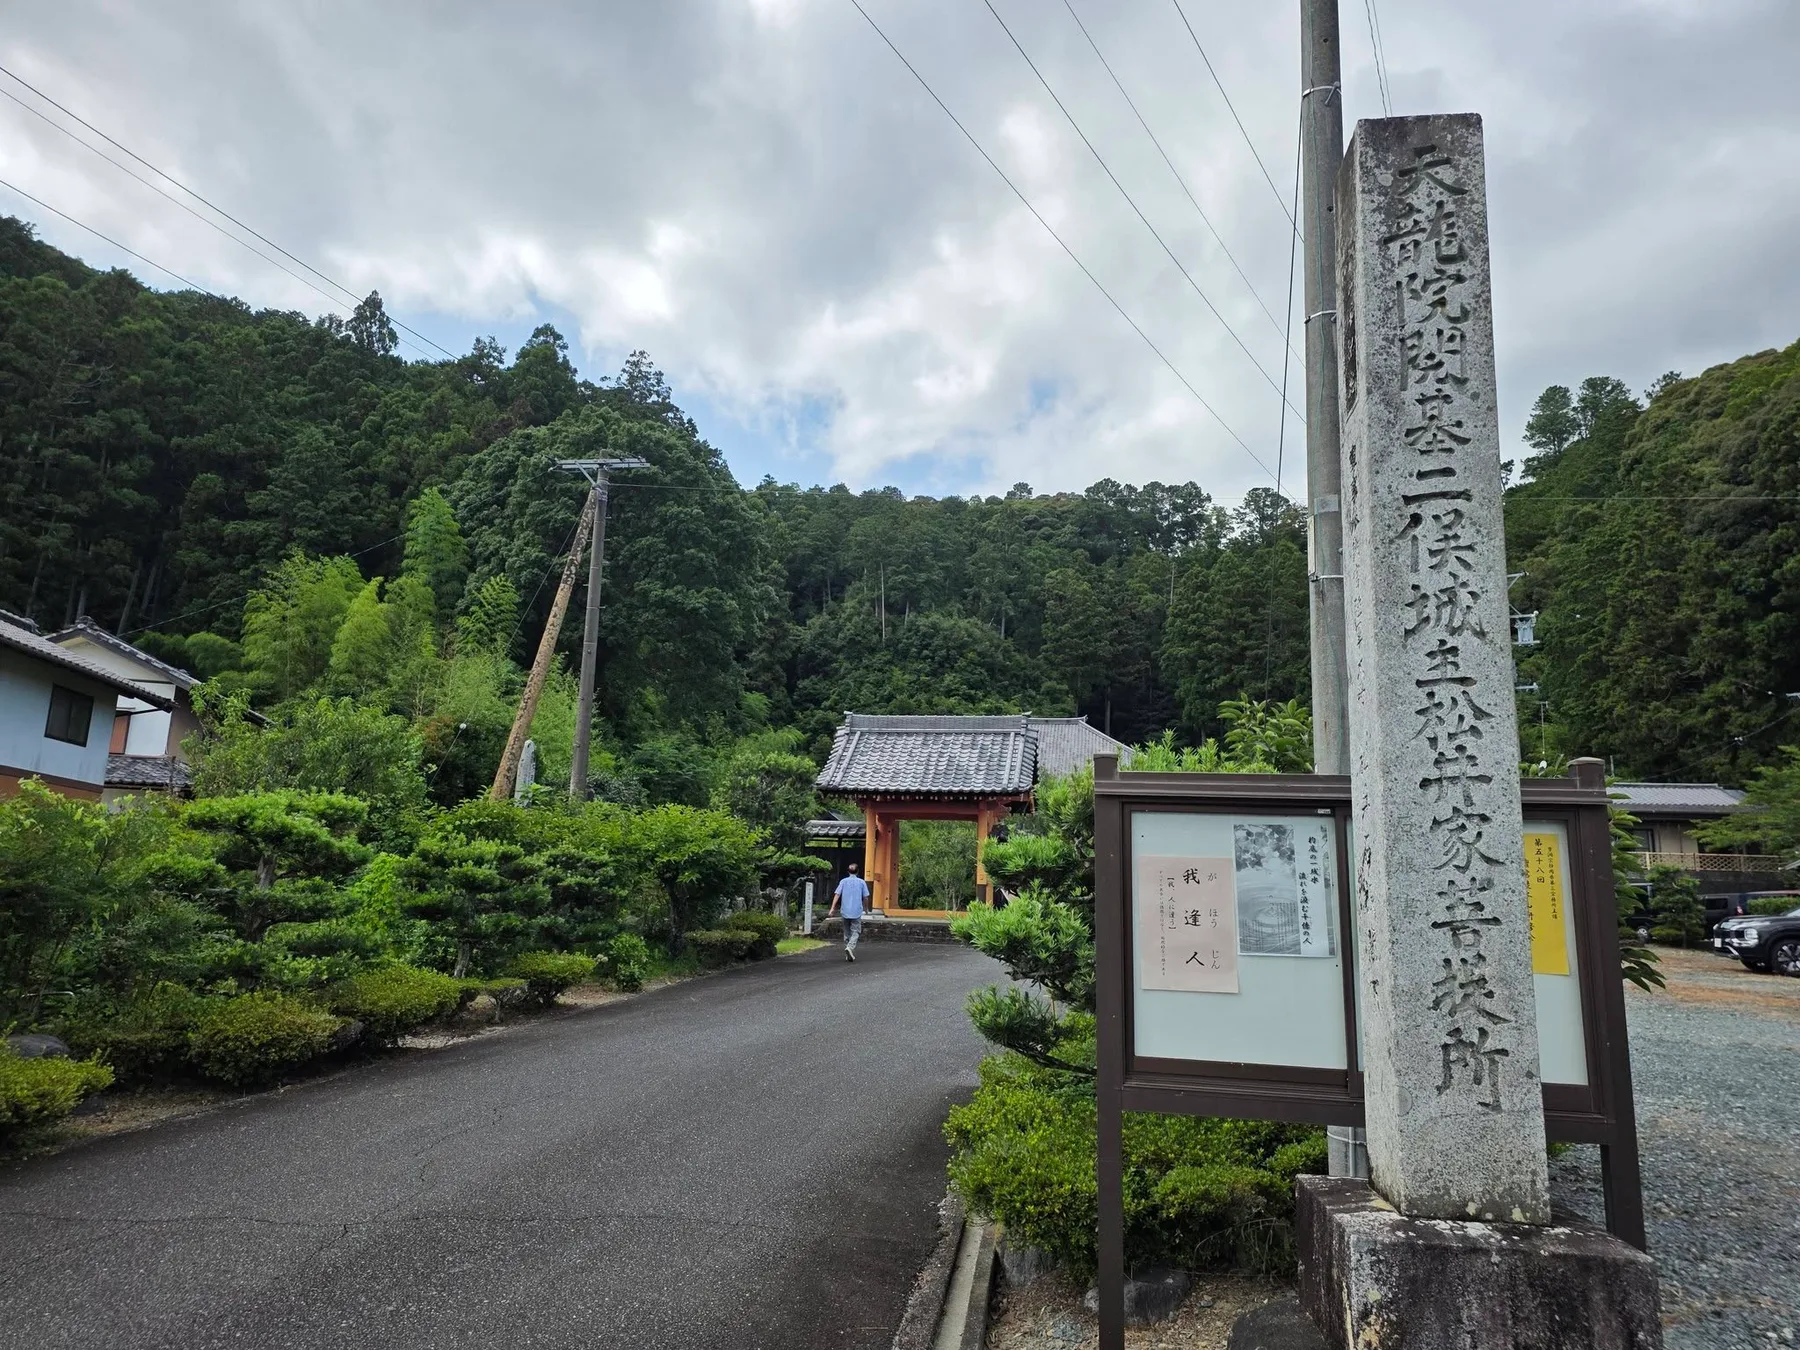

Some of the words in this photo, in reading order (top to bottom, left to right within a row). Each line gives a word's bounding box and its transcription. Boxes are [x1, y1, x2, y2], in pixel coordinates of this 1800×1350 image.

[1534, 838, 1545, 884] 第五十八回
[1183, 868, 1205, 967] 我逢人
